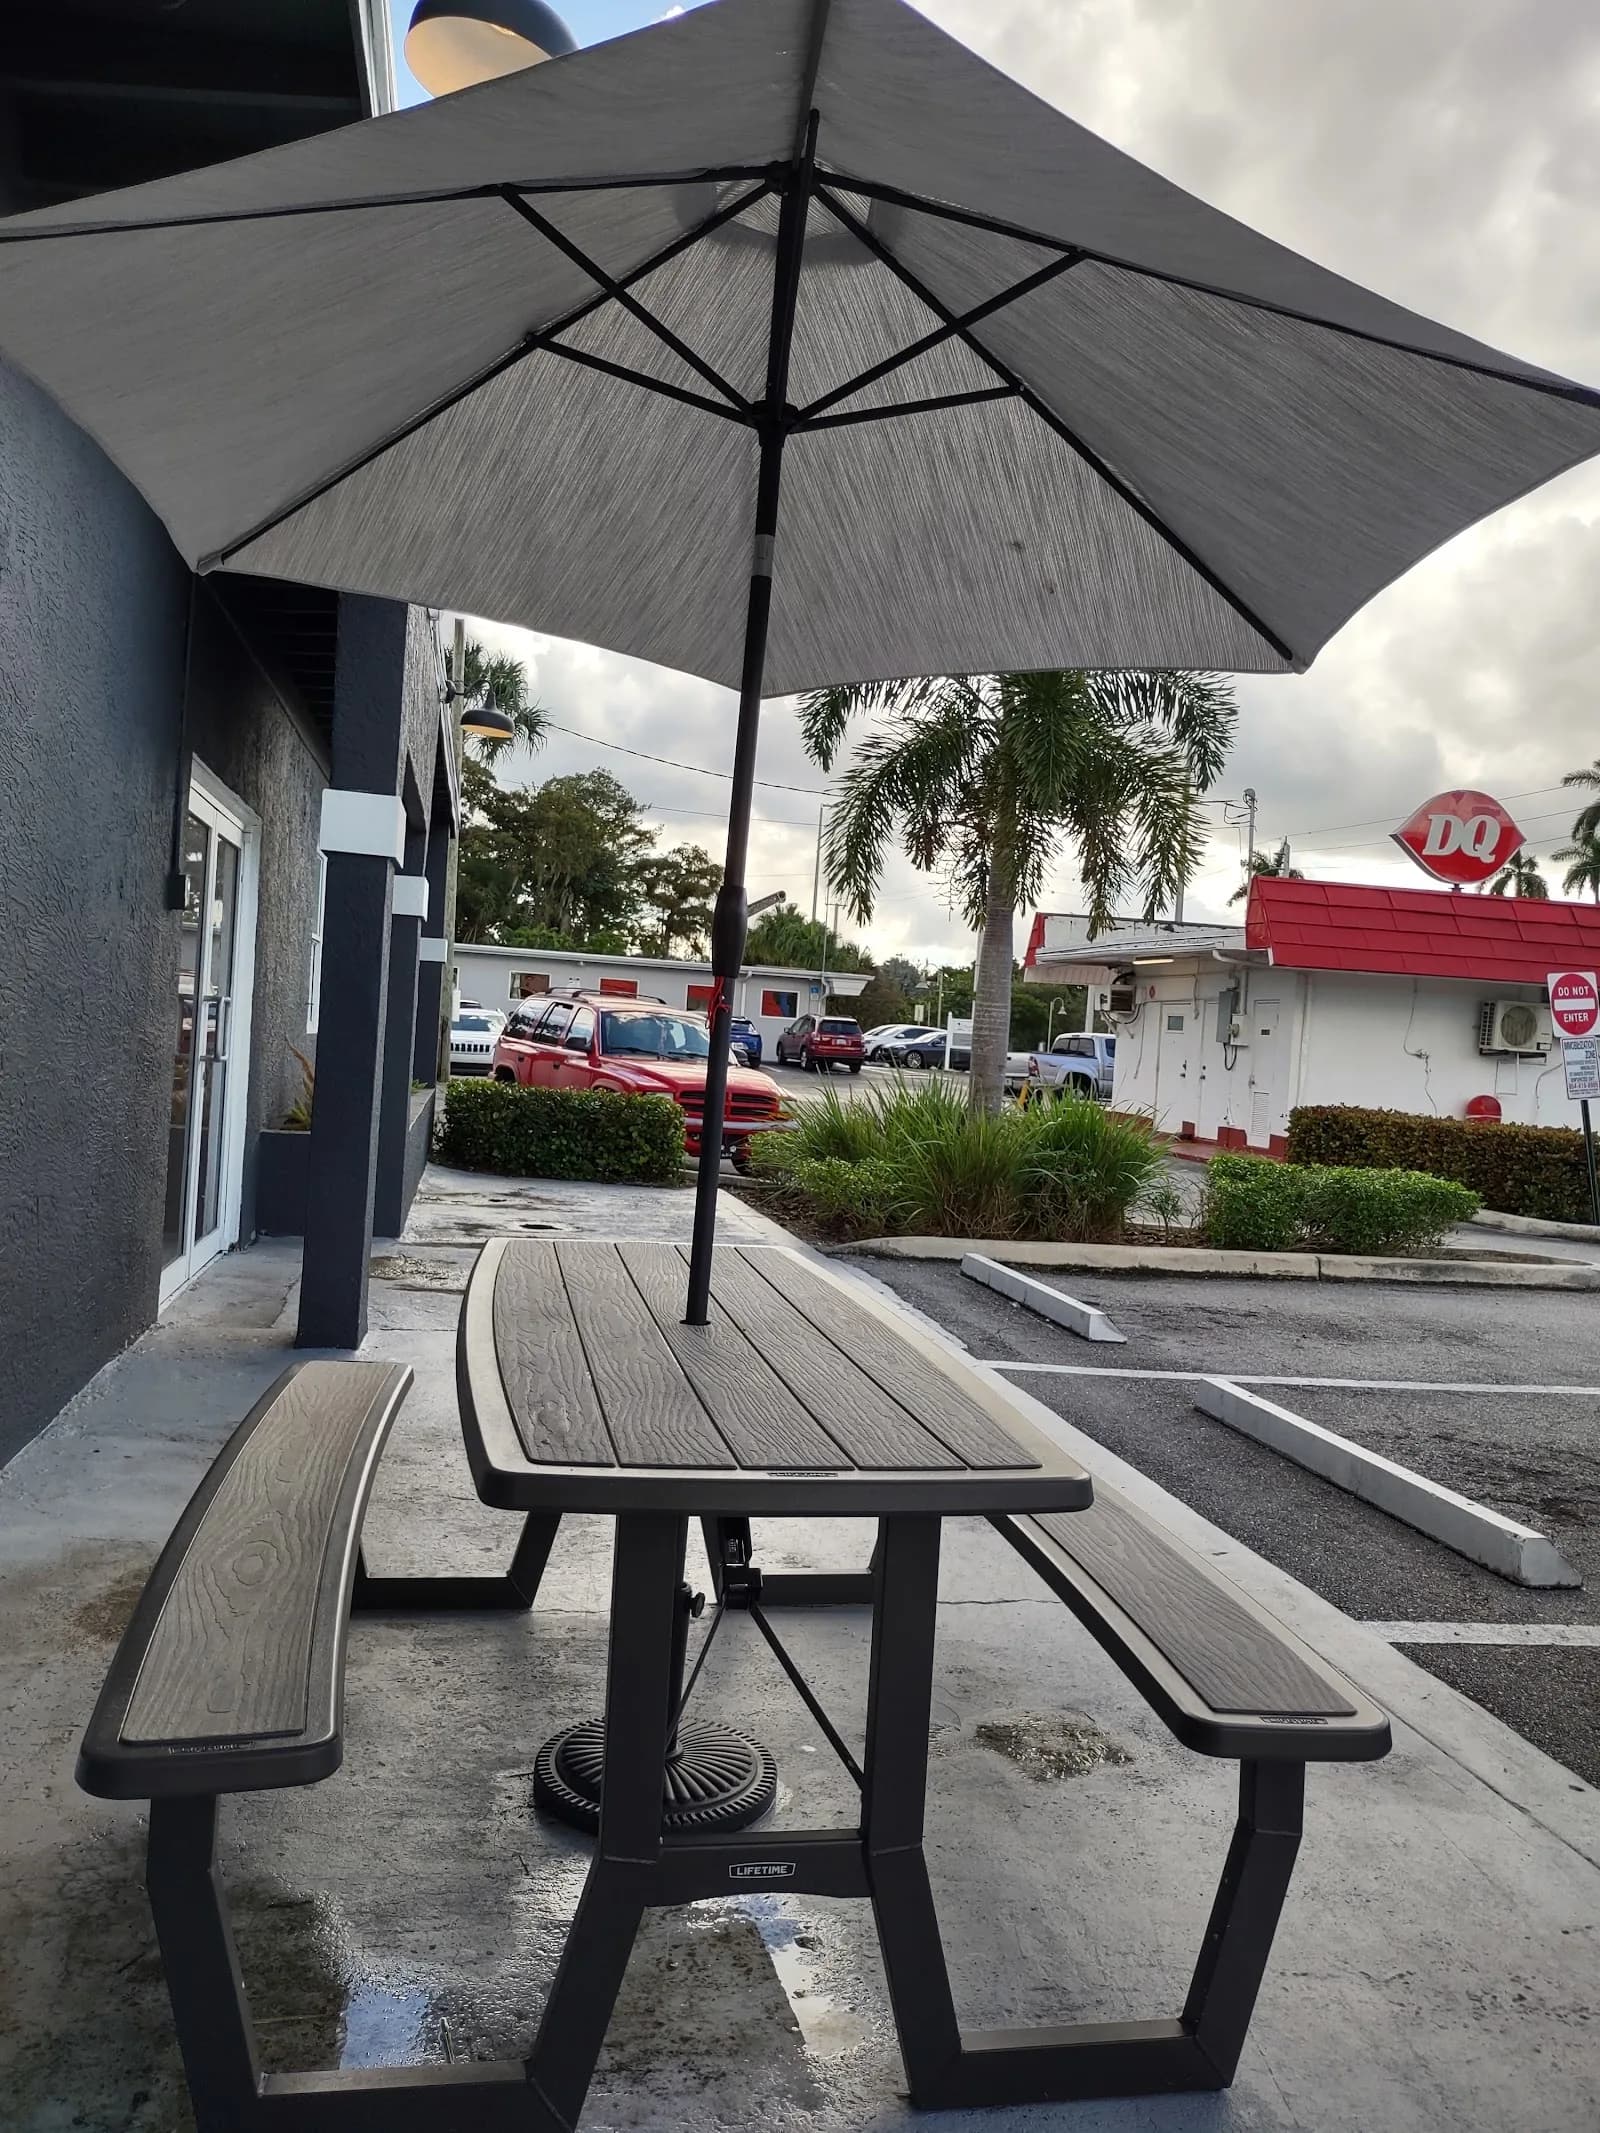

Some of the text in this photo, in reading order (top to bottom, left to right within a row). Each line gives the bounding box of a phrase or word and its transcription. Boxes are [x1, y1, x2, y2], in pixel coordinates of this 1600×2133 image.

[1421, 814, 1500, 864] DQ
[1558, 985, 1589, 997] DO NOT
[1563, 1012, 1589, 1023] ENTER
[736, 1865, 788, 1876] LIFETIME
